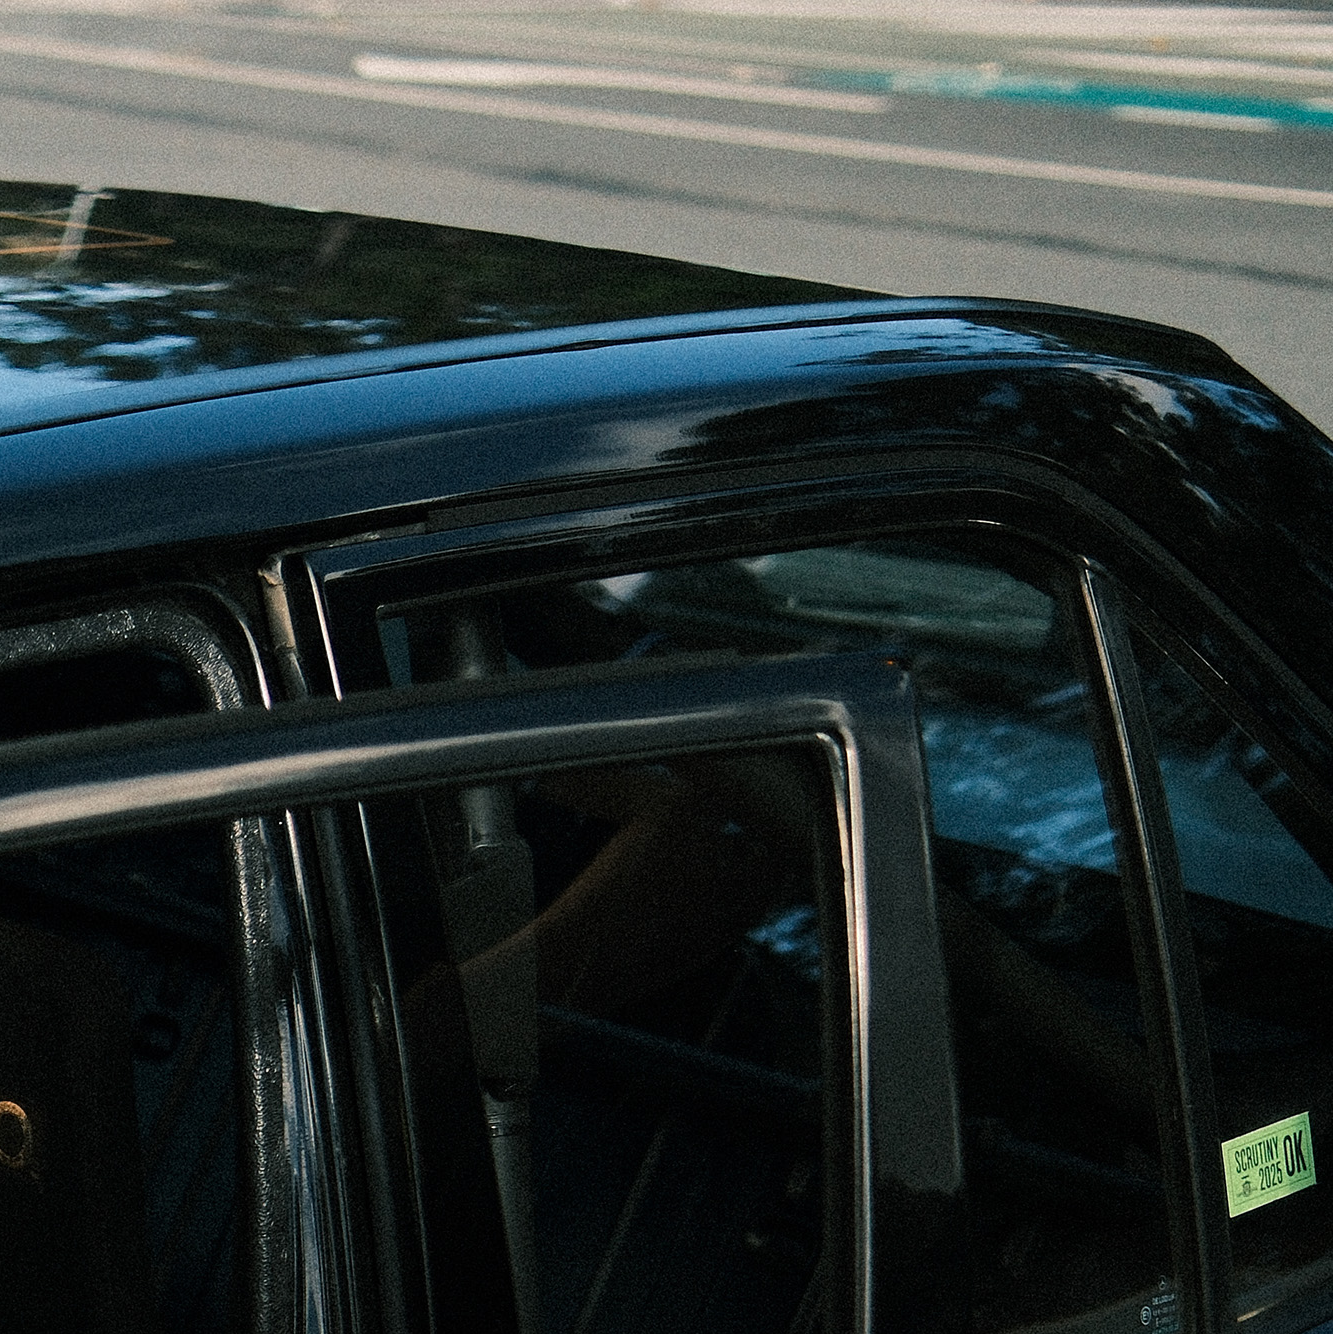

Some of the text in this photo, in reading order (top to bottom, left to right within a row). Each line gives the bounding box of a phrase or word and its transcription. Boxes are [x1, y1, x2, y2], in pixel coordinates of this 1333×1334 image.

[1234, 1130, 1308, 1177] SCRUTINY OK
[1258, 1161, 1284, 1191] 2025
